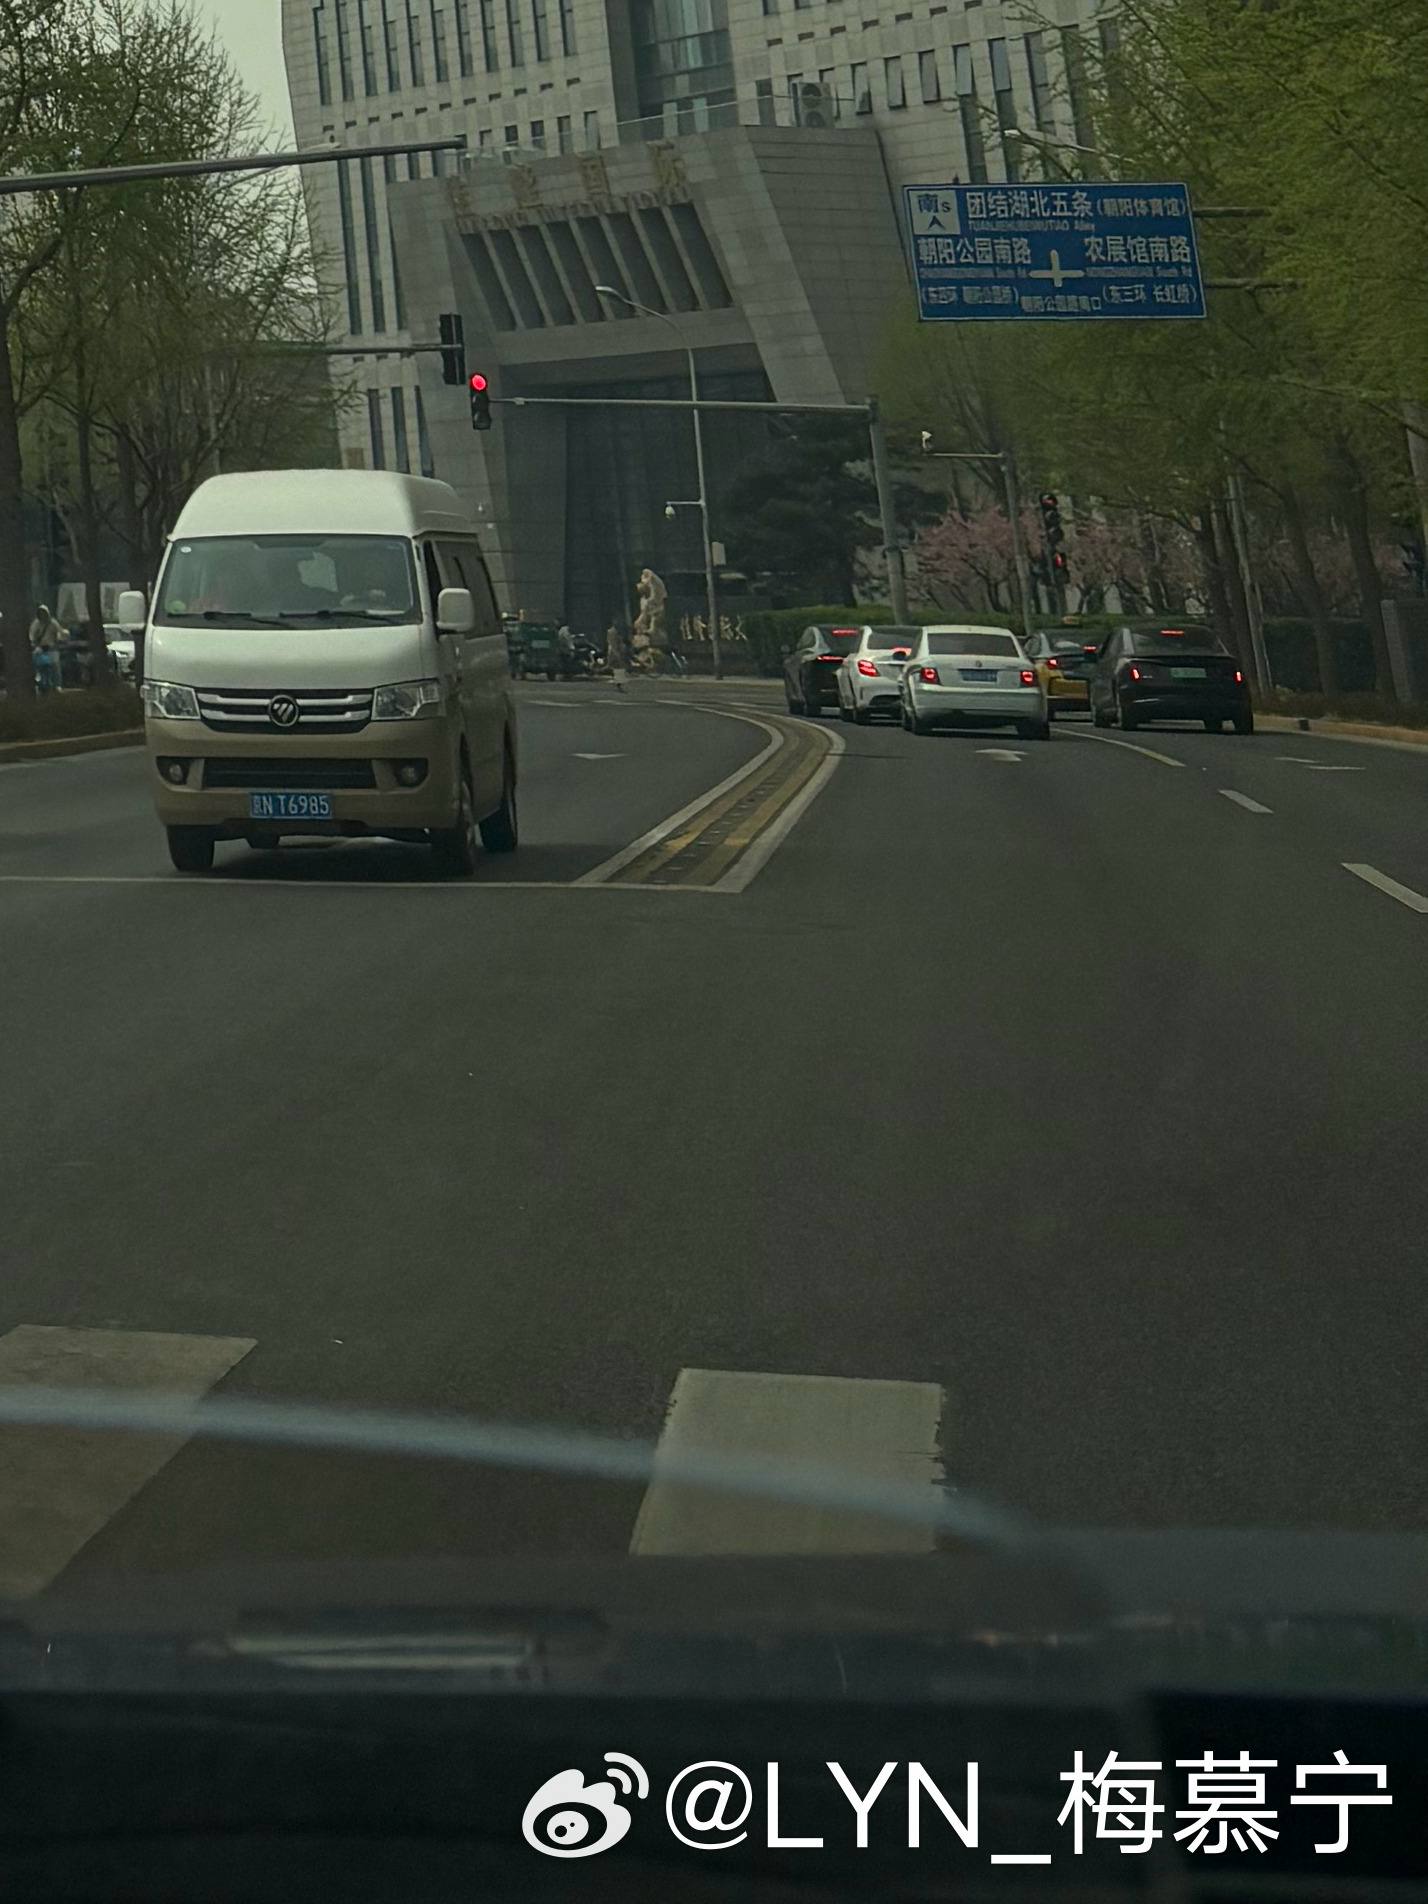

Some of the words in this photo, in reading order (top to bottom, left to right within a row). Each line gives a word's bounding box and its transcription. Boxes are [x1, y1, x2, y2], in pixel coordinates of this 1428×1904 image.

[965, 189, 1094, 219] 团结湖北五条
[917, 237, 1032, 265] 朝阳公园南路
[1084, 235, 1191, 264] 农展馆南路
[277, 794, 329, 815] T6985
